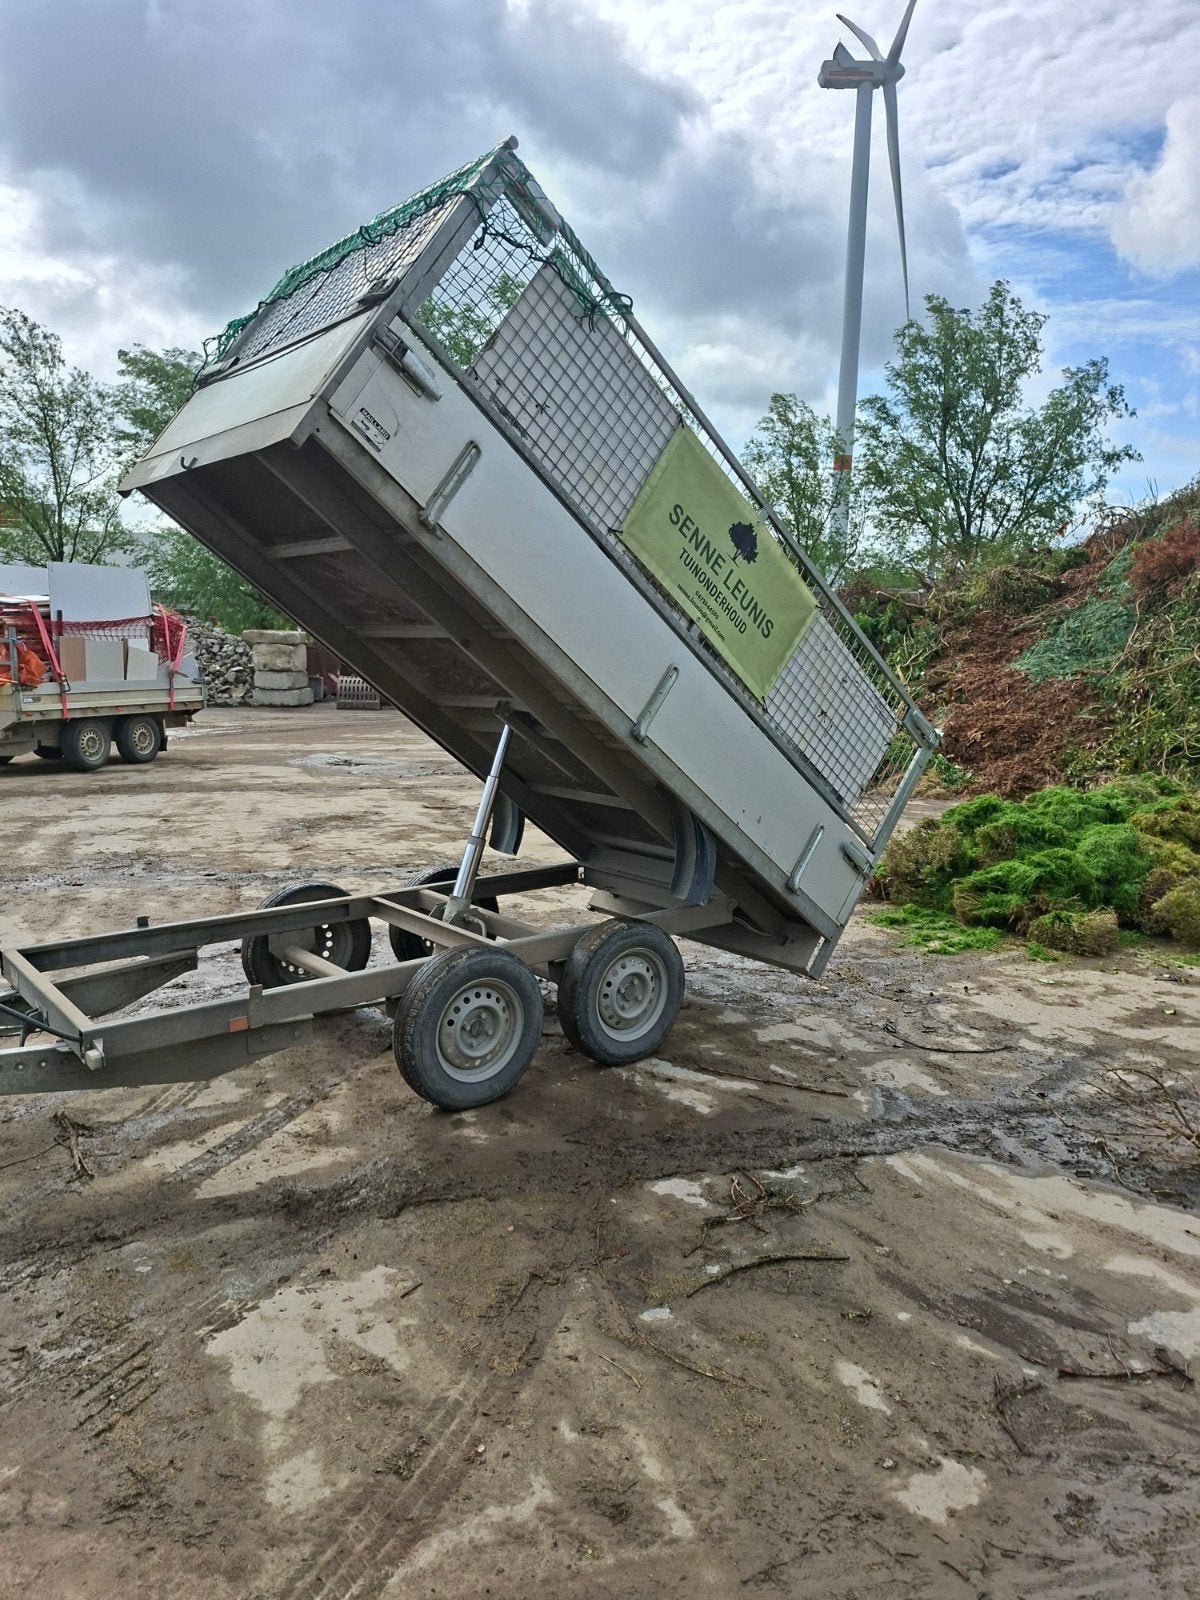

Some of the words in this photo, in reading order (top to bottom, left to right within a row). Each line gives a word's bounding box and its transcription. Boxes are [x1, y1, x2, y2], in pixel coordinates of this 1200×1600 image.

[669, 504, 726, 576] SENNE
[723, 569, 774, 639] LEUNIS
[679, 547, 747, 634] TUINONDERHOUD
